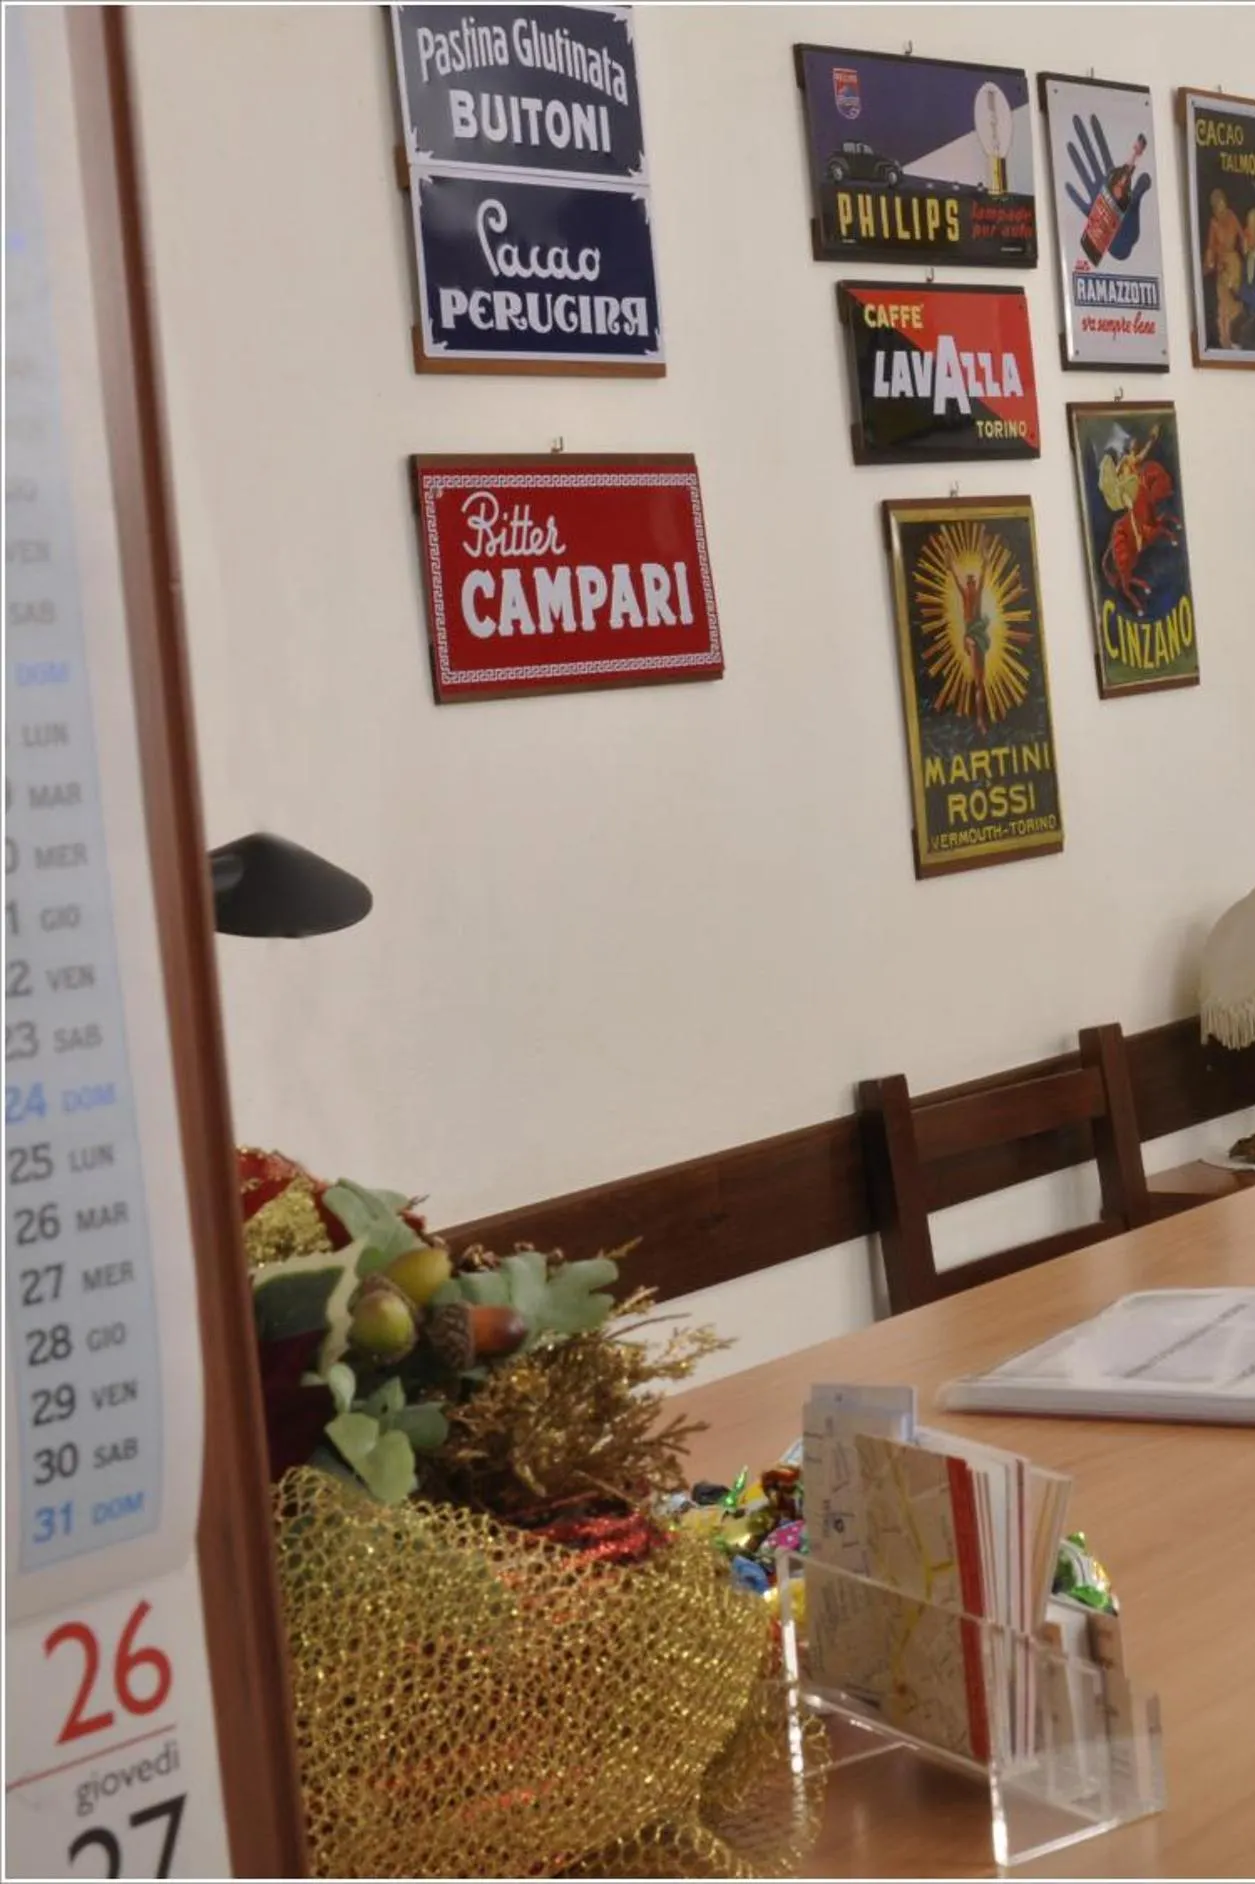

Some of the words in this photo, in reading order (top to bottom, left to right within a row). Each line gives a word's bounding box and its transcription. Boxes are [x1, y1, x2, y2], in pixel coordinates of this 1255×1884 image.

[417, 17, 508, 82] Pastina
[512, 18, 629, 106] Glutinata
[450, 89, 612, 153] BUITONI
[1194, 118, 1244, 147] CACAO
[477, 198, 602, 281] Cacao
[837, 192, 961, 242] PHILIPS
[1076, 278, 1157, 305] RAMAZZOTTI
[873, 334, 1024, 415] LAVAZZA
[976, 420, 1028, 438] TORINO
[461, 491, 567, 558] Bitter
[461, 562, 694, 639] CAMPARI
[1103, 595, 1193, 669] CINZANO
[925, 741, 1050, 788] MARTINI
[947, 781, 1035, 824] ROSSI
[5, 836, 20, 876] 0
[34, 841, 88, 870] MER
[5, 899, 20, 936] 1
[46, 965, 95, 992] VEN
[53, 1023, 103, 1053] SAB
[5, 1082, 48, 1126] 24
[9, 1142, 54, 1186] 25
[67, 1144, 116, 1174] LUN
[14, 1203, 61, 1247] 26
[76, 1201, 130, 1233] MAR
[20, 1262, 67, 1307] 27
[82, 1260, 136, 1294] MER
[25, 1323, 74, 1368] 28
[86, 1322, 128, 1352] GIO
[31, 1383, 77, 1428] 29
[91, 1379, 139, 1410] VEN
[33, 1442, 79, 1487] 30
[93, 1437, 140, 1470] SAB
[33, 1501, 75, 1544] 31
[92, 1491, 146, 1526] DOM
[42, 1599, 174, 1747] 26
